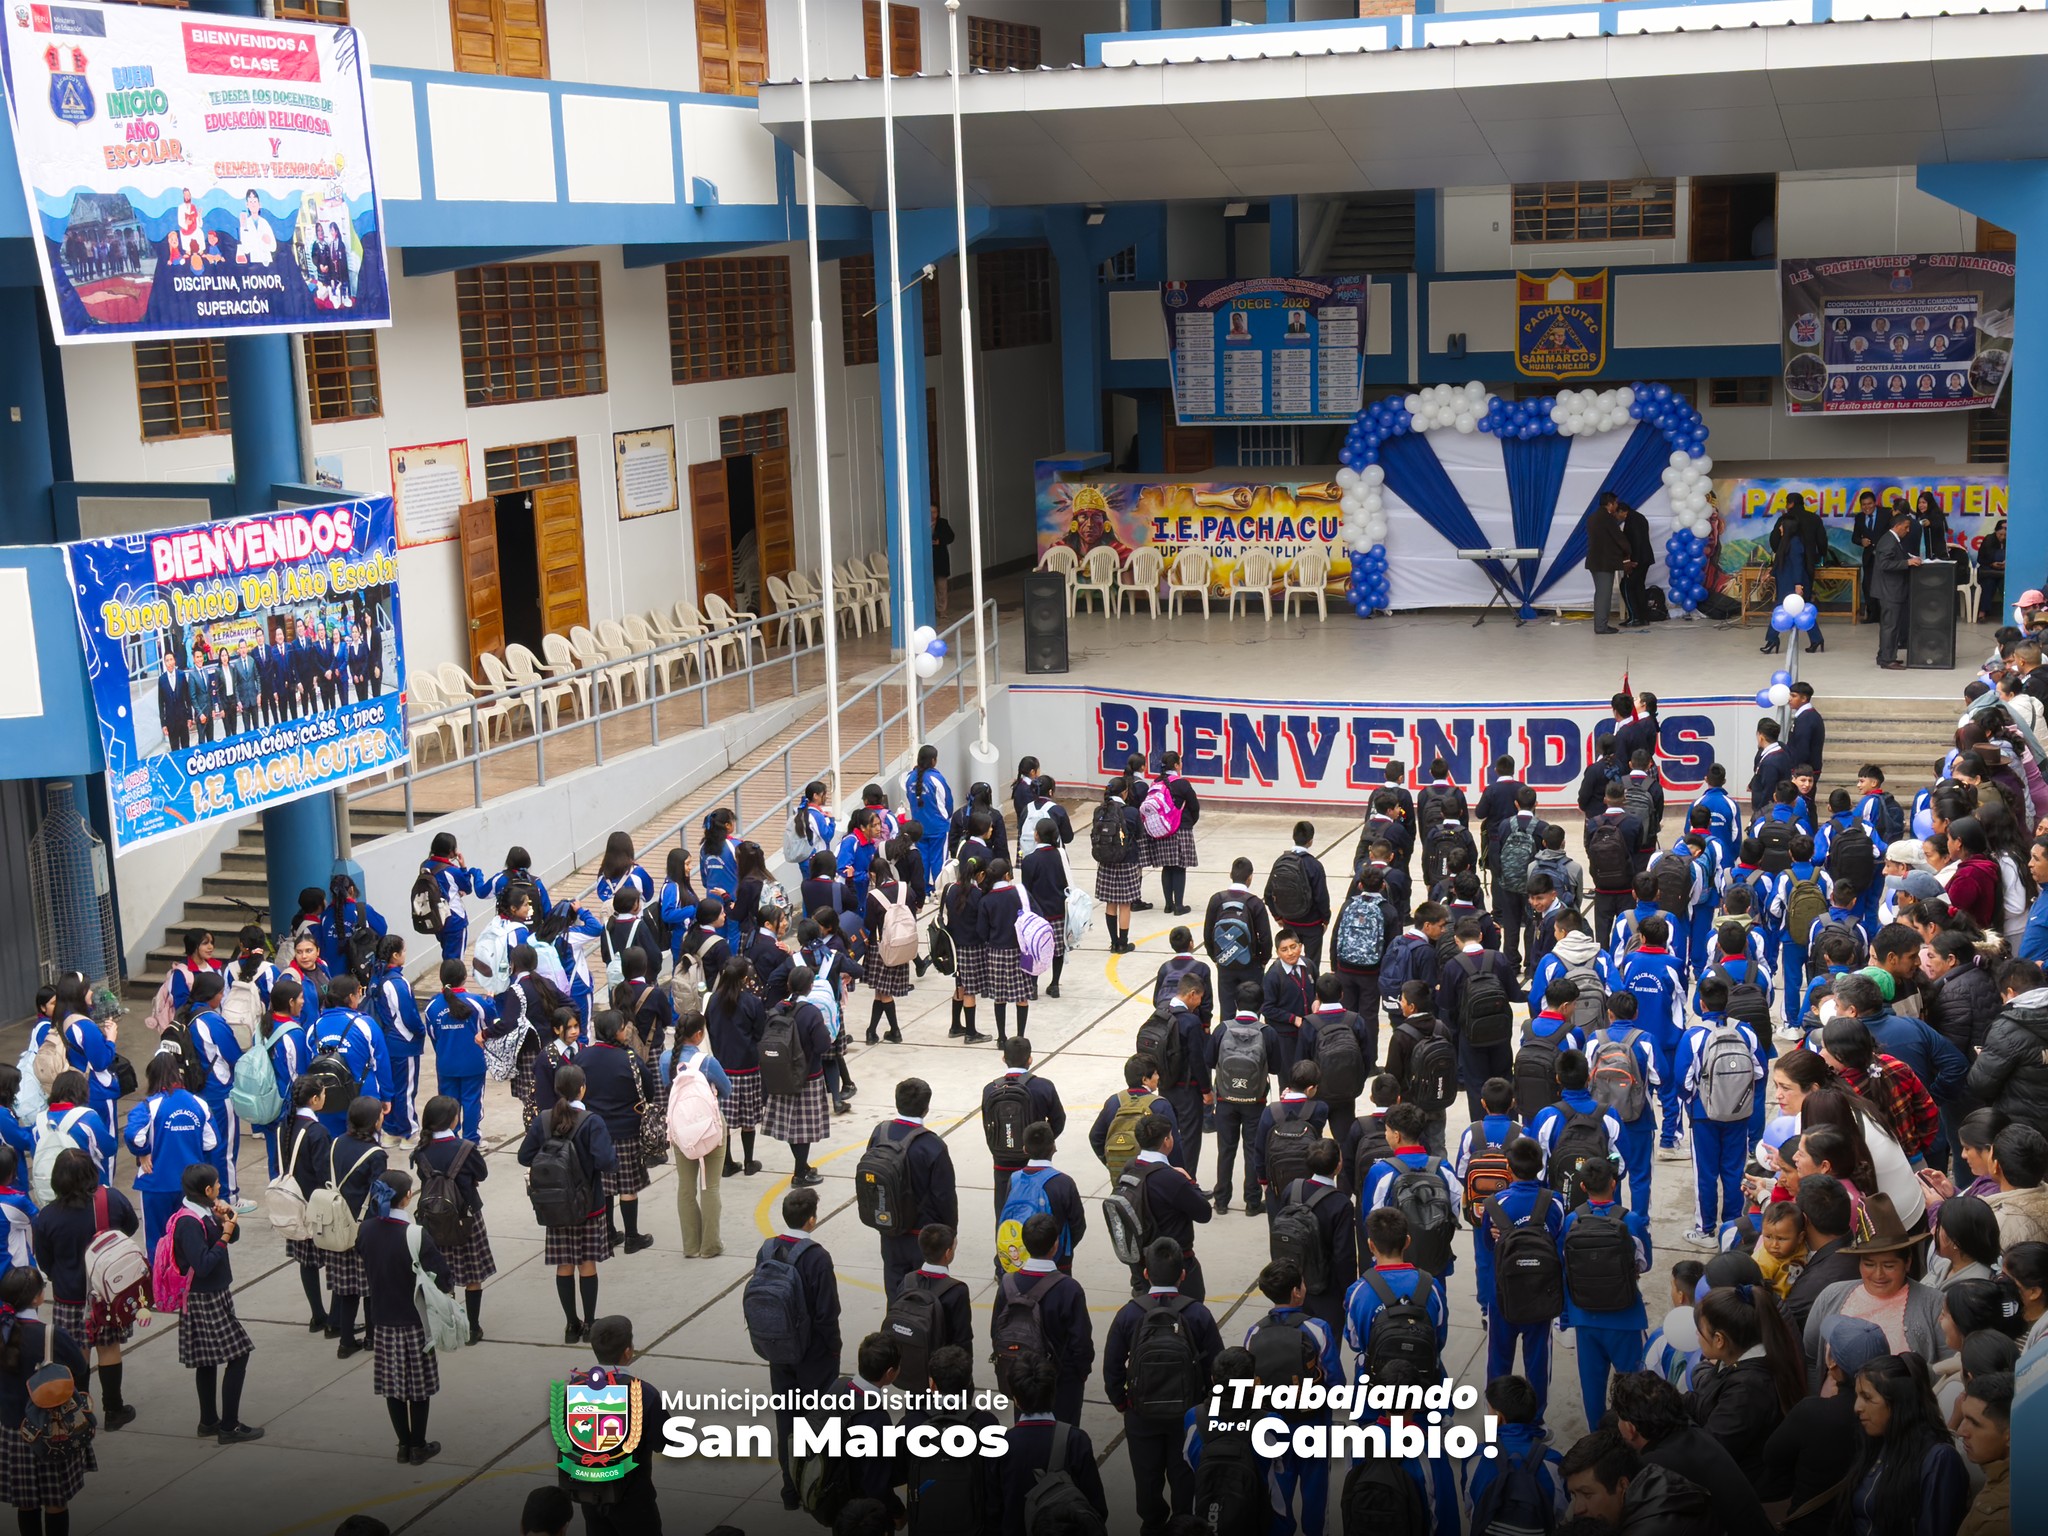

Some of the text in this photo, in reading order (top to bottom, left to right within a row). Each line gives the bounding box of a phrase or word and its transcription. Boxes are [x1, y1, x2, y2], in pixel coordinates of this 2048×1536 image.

[192, 29, 309, 52] BIENVENIDOS A
[230, 56, 279, 72] CLASE
[112, 65, 154, 91] BUEN
[106, 89, 168, 119] INICIO
[209, 89, 333, 113] TE DESEA LOS DOCENTES DE
[126, 118, 160, 142] AÑO
[204, 108, 332, 136] EDUCACIÓN RELIGIOSA
[103, 139, 185, 170] ESCOLAR
[269, 138, 281, 158] Y
[214, 161, 261, 179] CIENCIA
[1789, 268, 1814, 285] I.E.
[1929, 255, 1957, 267] SAN
[1959, 256, 2016, 277] MARCOS
[173, 274, 285, 293] DISCIPLINA, HONOR,
[197, 295, 269, 316] SUPERACIÓN
[1232, 299, 1271, 310] TOECE
[1282, 298, 1311, 309] 2026
[1905, 305, 1959, 313] COMUNICACIÓN
[1524, 305, 1598, 334] PACHACUTEC
[1522, 353, 1597, 364] SAN MARCOS
[1918, 362, 1941, 370] INGLÉS
[1839, 401, 1860, 410] éxito
[1862, 400, 1881, 409] está
[1912, 400, 1943, 408] manos
[151, 508, 354, 584] BIENVENIDOS
[102, 549, 398, 640] Buen Inicio Del Año Escolar
[186, 704, 386, 776] COORDINACIÓN: CC.SS. Y DPCC
[1098, 702, 1715, 790] BIENVENIDS
[190, 730, 388, 815] I.E. PACHACUTEC
[125, 797, 153, 822] MEJOR
[1218, 945, 1239, 964] adidas
